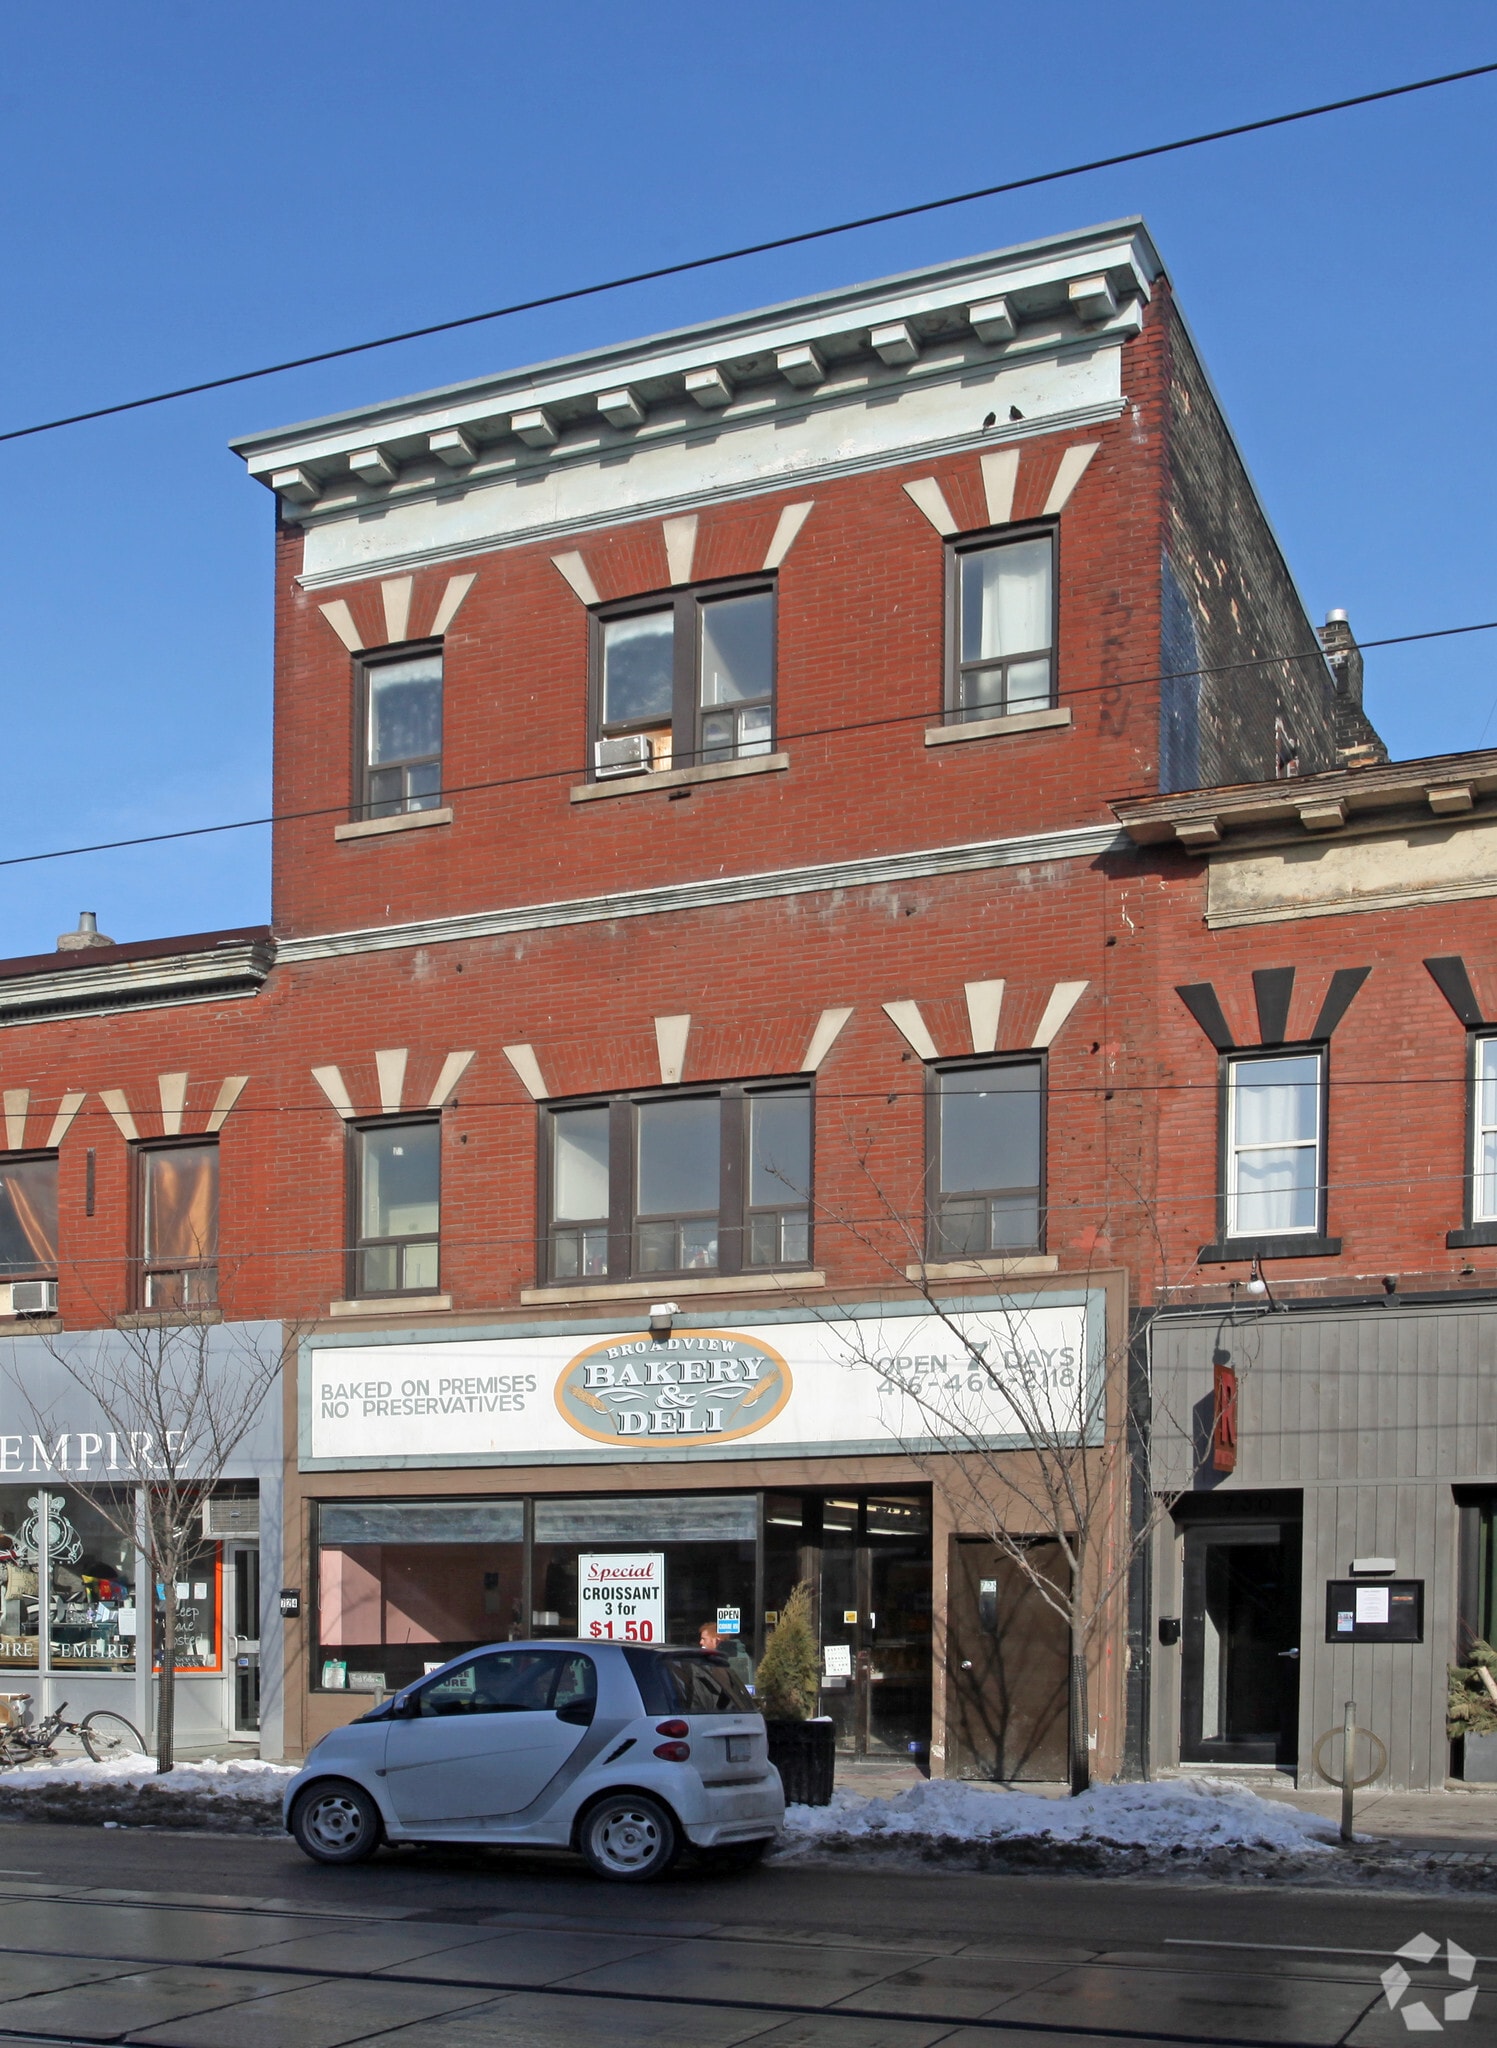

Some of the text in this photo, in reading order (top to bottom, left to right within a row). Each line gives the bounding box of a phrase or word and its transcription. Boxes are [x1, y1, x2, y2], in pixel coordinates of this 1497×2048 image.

[606, 1338, 736, 1359] BROADVIEW
[878, 1342, 1075, 1374] OPEN 7 DAYS
[583, 1357, 765, 1388] BAKERY
[321, 1374, 537, 1401] BAKED ON PREMISES
[654, 1385, 698, 1409] &
[321, 1394, 525, 1419] NO PRESERVATIVES
[617, 1408, 723, 1435] DELI
[0, 1431, 190, 1472] EMPIRE
[587, 1562, 654, 1582] Special
[583, 1587, 660, 1600] CROISSANT
[605, 1602, 636, 1615] 3 for
[718, 1610, 739, 1620] OPEN
[589, 1620, 653, 1642] $1.50
[61, 1643, 130, 1659] EMPIRE
